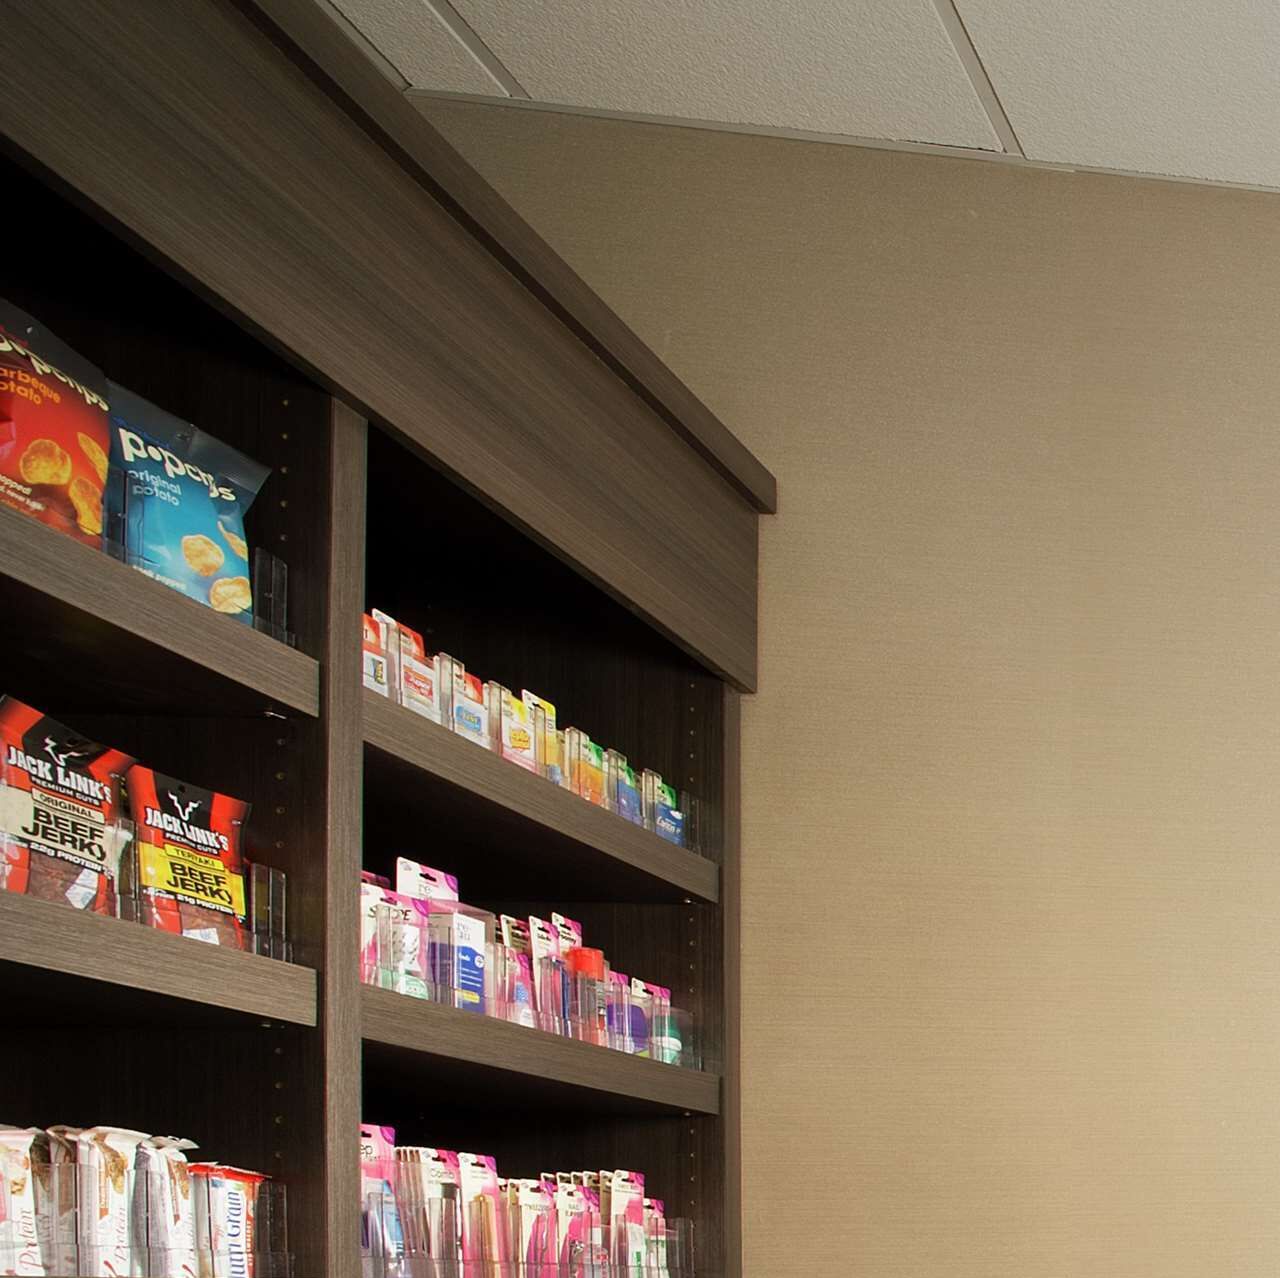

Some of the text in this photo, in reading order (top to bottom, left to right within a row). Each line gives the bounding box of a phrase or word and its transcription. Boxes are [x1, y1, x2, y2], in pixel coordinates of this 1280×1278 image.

[0, 367, 60, 403] arbeque
[0, 380, 41, 405] otato
[118, 427, 236, 501] popchips
[133, 485, 180, 506] potato
[8, 745, 112, 804] JACK LINK'S
[39, 793, 95, 818] ORIGINAL
[33, 806, 104, 841] BEEF
[145, 807, 229, 851] JACK LINK'S
[170, 862, 226, 887] BEEF
